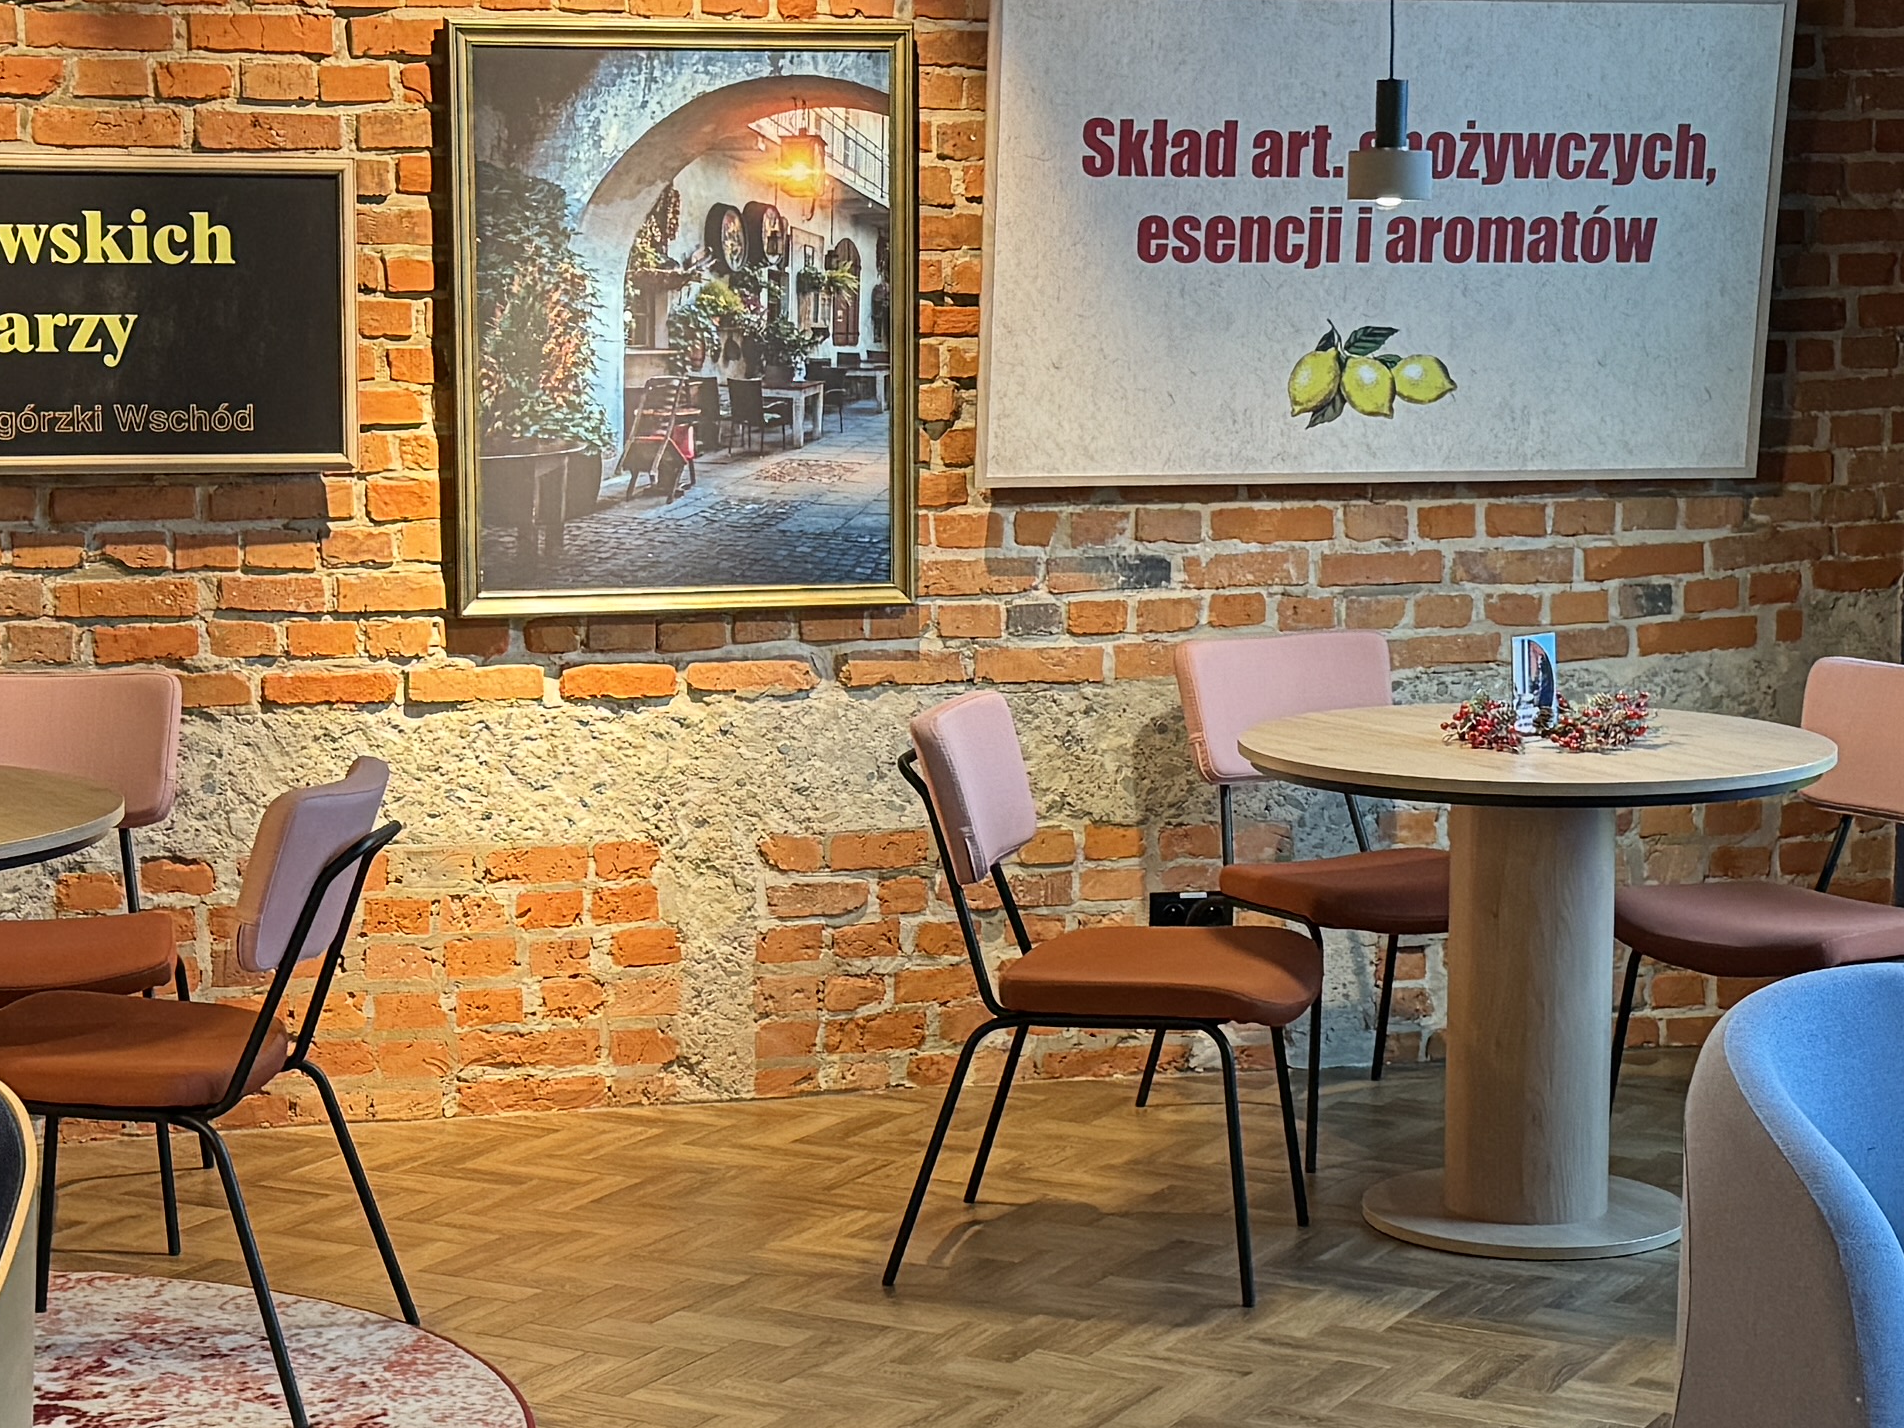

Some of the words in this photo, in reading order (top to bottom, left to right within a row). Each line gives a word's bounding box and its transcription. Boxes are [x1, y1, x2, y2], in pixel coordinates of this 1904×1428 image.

[1081, 116, 1238, 180] Skład
[1252, 123, 1344, 180] art.
[1358, 119, 1718, 188] ożywczych,
[1136, 205, 1342, 270] esencji
[1356, 206, 1373, 264] i
[1385, 204, 1658, 265] aromatów
[114, 401, 256, 434] Wschód
